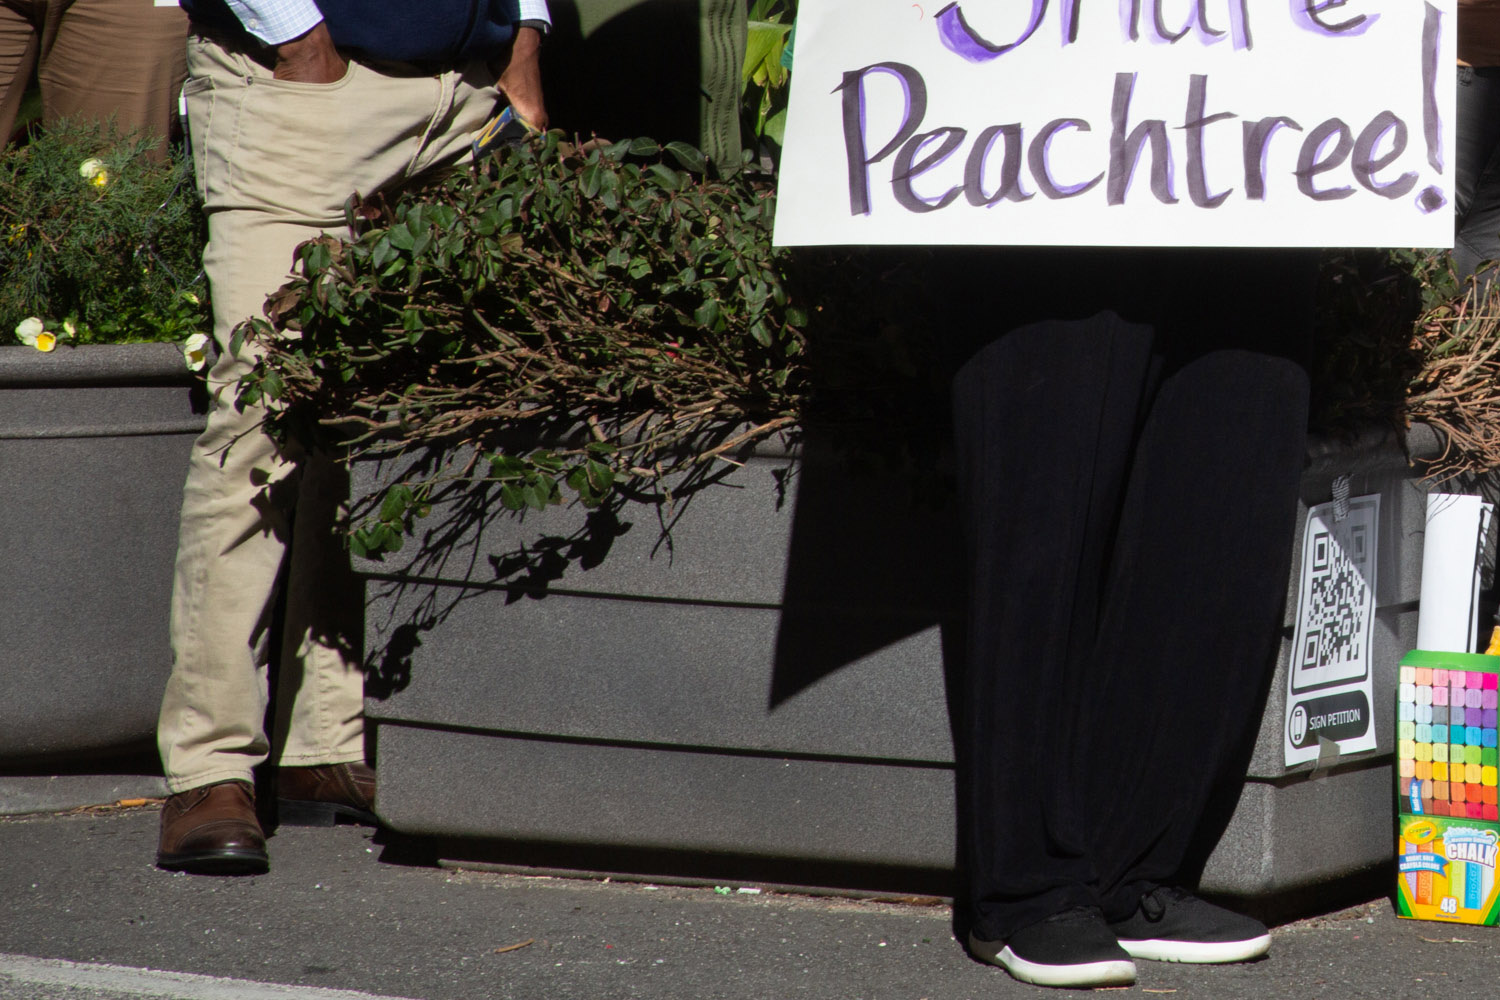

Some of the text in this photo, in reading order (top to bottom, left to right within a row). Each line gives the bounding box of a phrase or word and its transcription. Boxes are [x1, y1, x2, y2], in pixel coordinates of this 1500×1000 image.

[830, 0, 1448, 216] Peachtree!
[1309, 709, 1360, 730] SIGN PETITION
[1447, 842, 1497, 868] CHALK
[1440, 897, 1458, 914] 48
